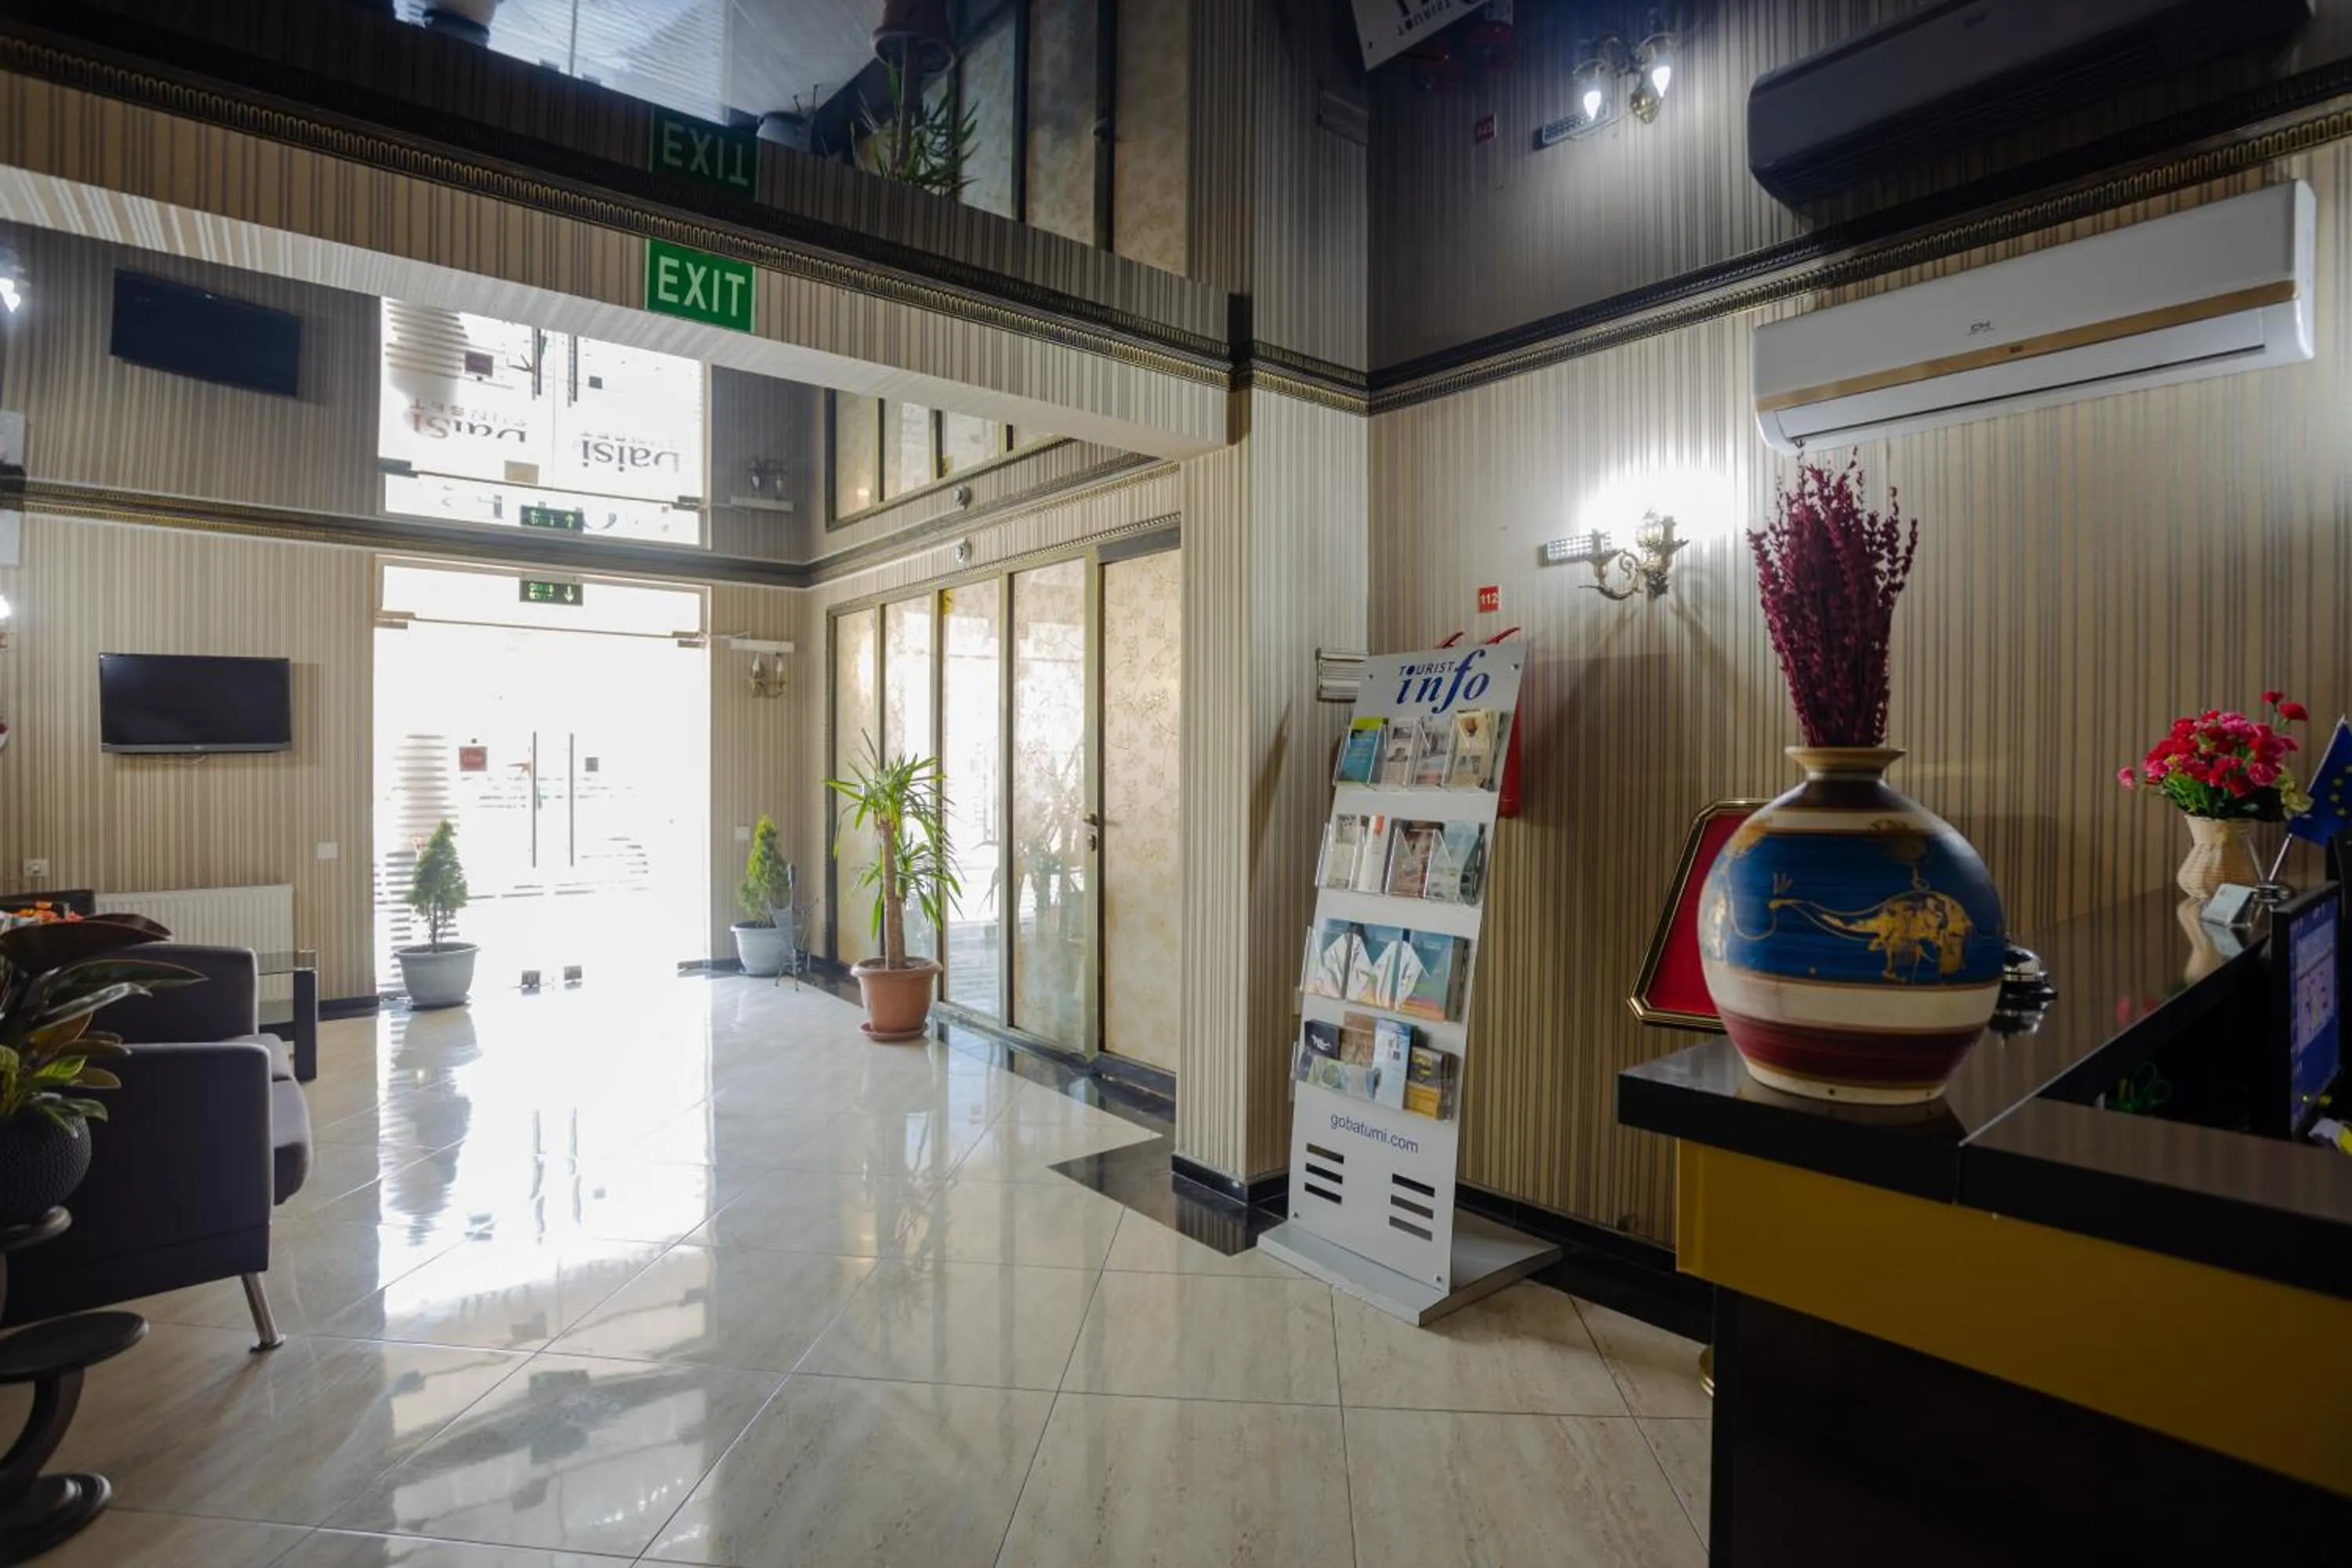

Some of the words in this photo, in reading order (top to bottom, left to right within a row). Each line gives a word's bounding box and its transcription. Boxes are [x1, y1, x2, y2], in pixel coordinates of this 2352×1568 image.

[658, 254, 746, 318] EXIT
[1479, 592, 1498, 605] 112
[1396, 648, 1490, 714] info
[1399, 661, 1456, 676] TOURIST
[1330, 1114, 1419, 1154] gobatumi.com
